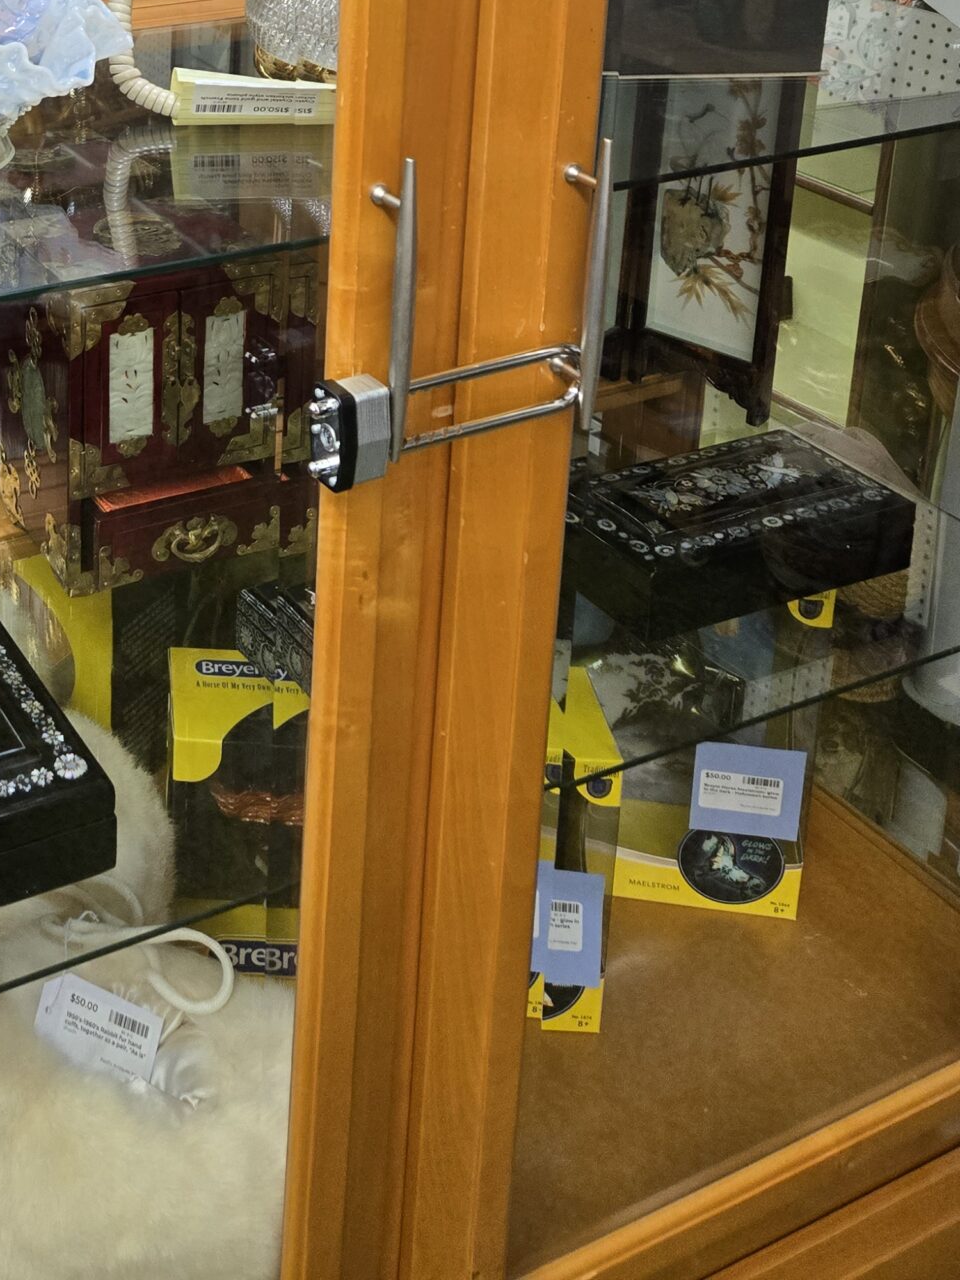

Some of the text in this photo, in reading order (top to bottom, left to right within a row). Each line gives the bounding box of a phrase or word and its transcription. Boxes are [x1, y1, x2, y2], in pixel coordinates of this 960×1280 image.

[202, 680, 220, 688] Horse
[242, 683, 256, 691] Very
[705, 772, 731, 781] $50.00
[741, 839, 772, 851] GLOWS
[629, 878, 680, 891] MAELSTROM
[70, 992, 99, 1013] $50.00
